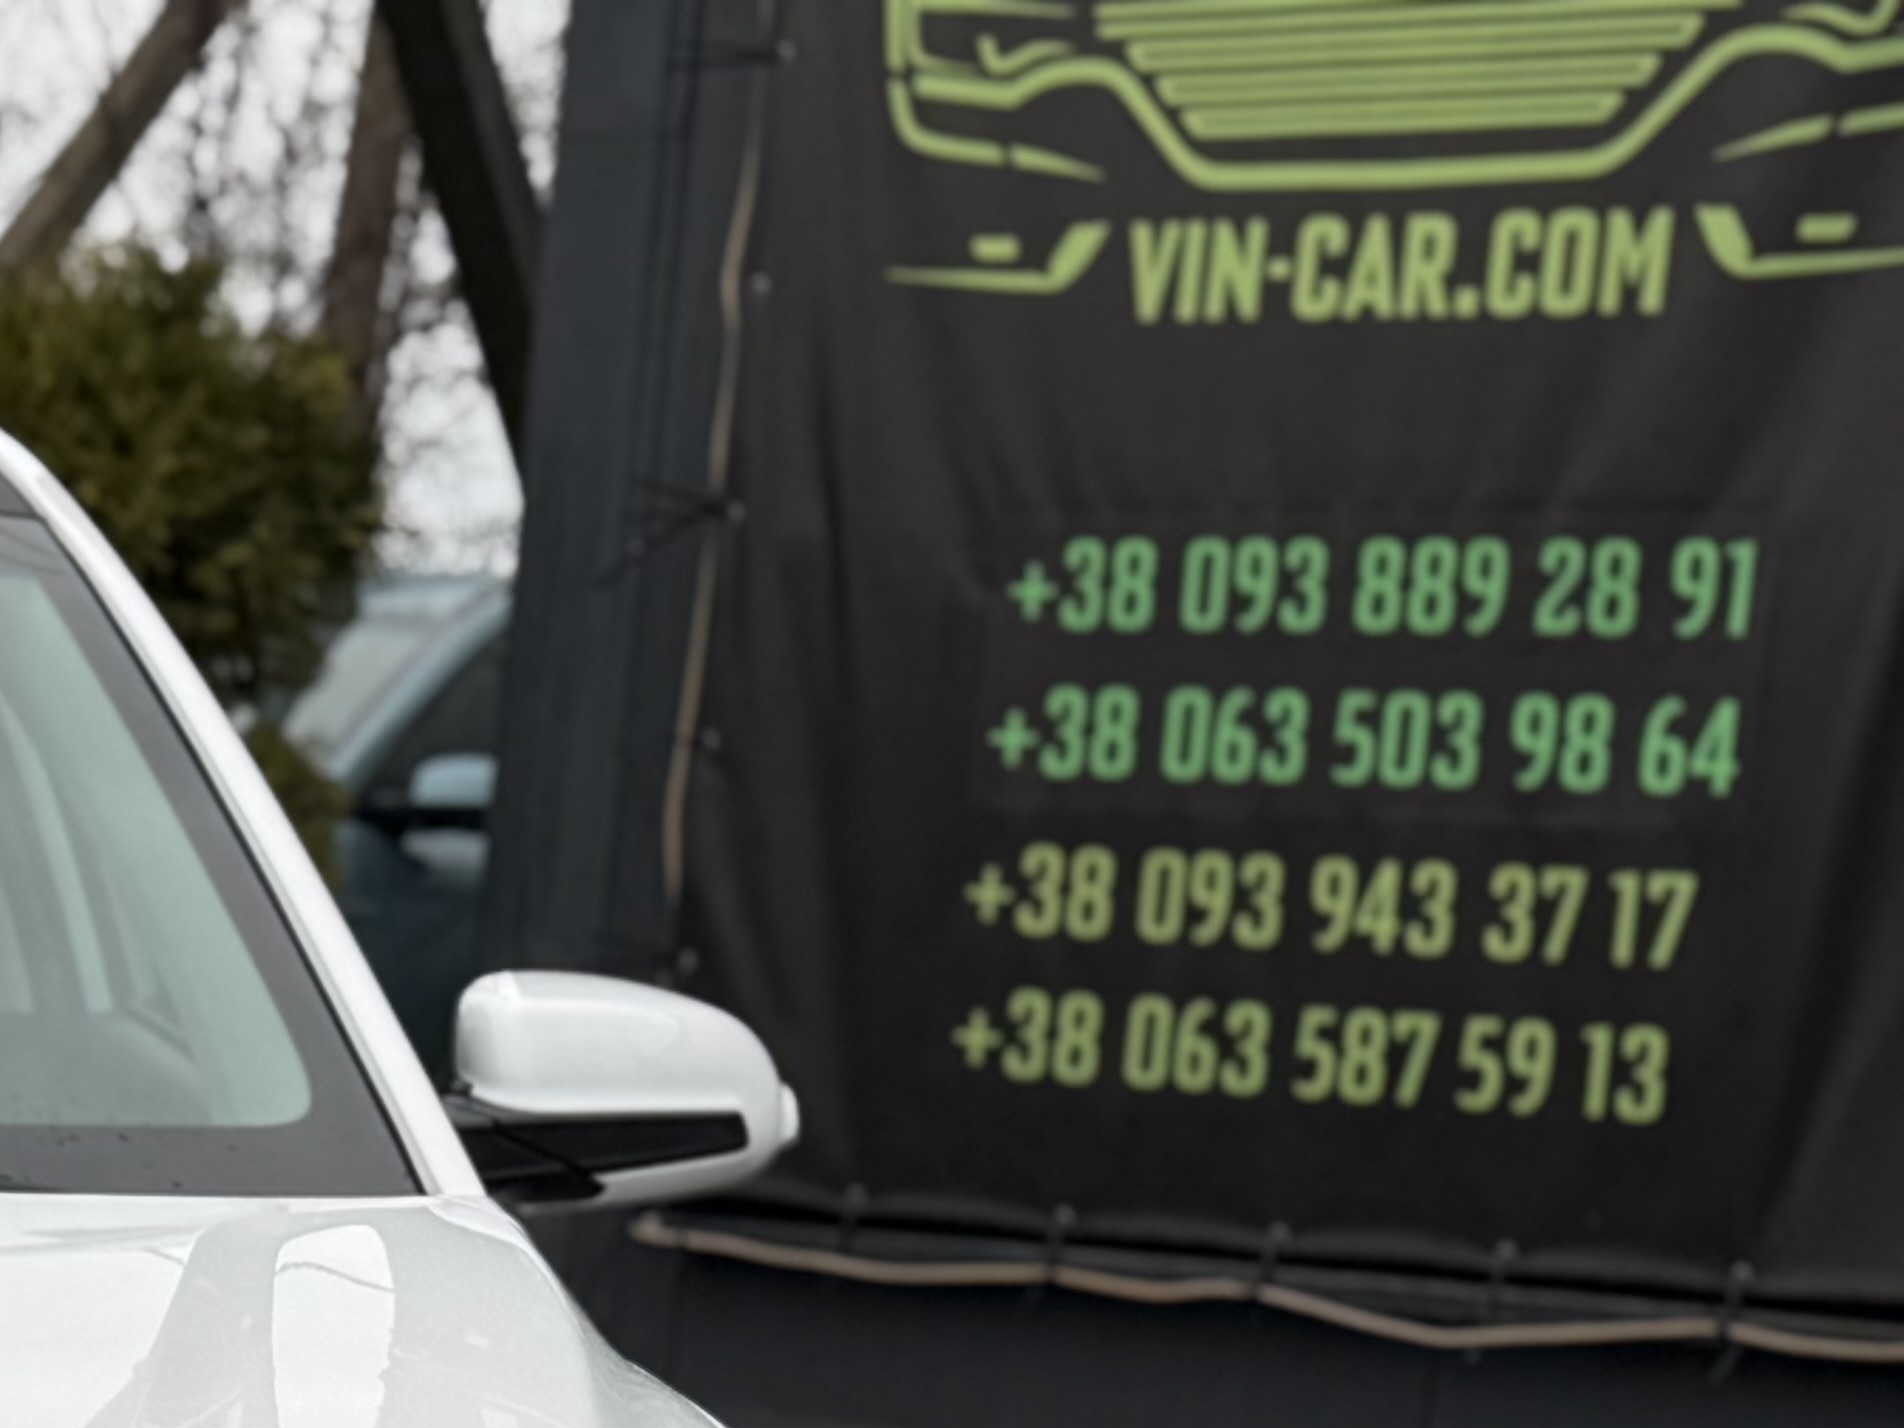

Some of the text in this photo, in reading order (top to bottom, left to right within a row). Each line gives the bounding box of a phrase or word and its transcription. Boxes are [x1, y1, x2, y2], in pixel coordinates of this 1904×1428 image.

[1128, 205, 1676, 325] VIN-CAR.COM
[1007, 533, 1759, 641] +38 093 889 28 91
[987, 682, 1742, 798] +38 063 503 98 64
[965, 840, 1699, 971] +38 093 943 37 17
[952, 985, 1669, 1126] +38 063 587 59 13
